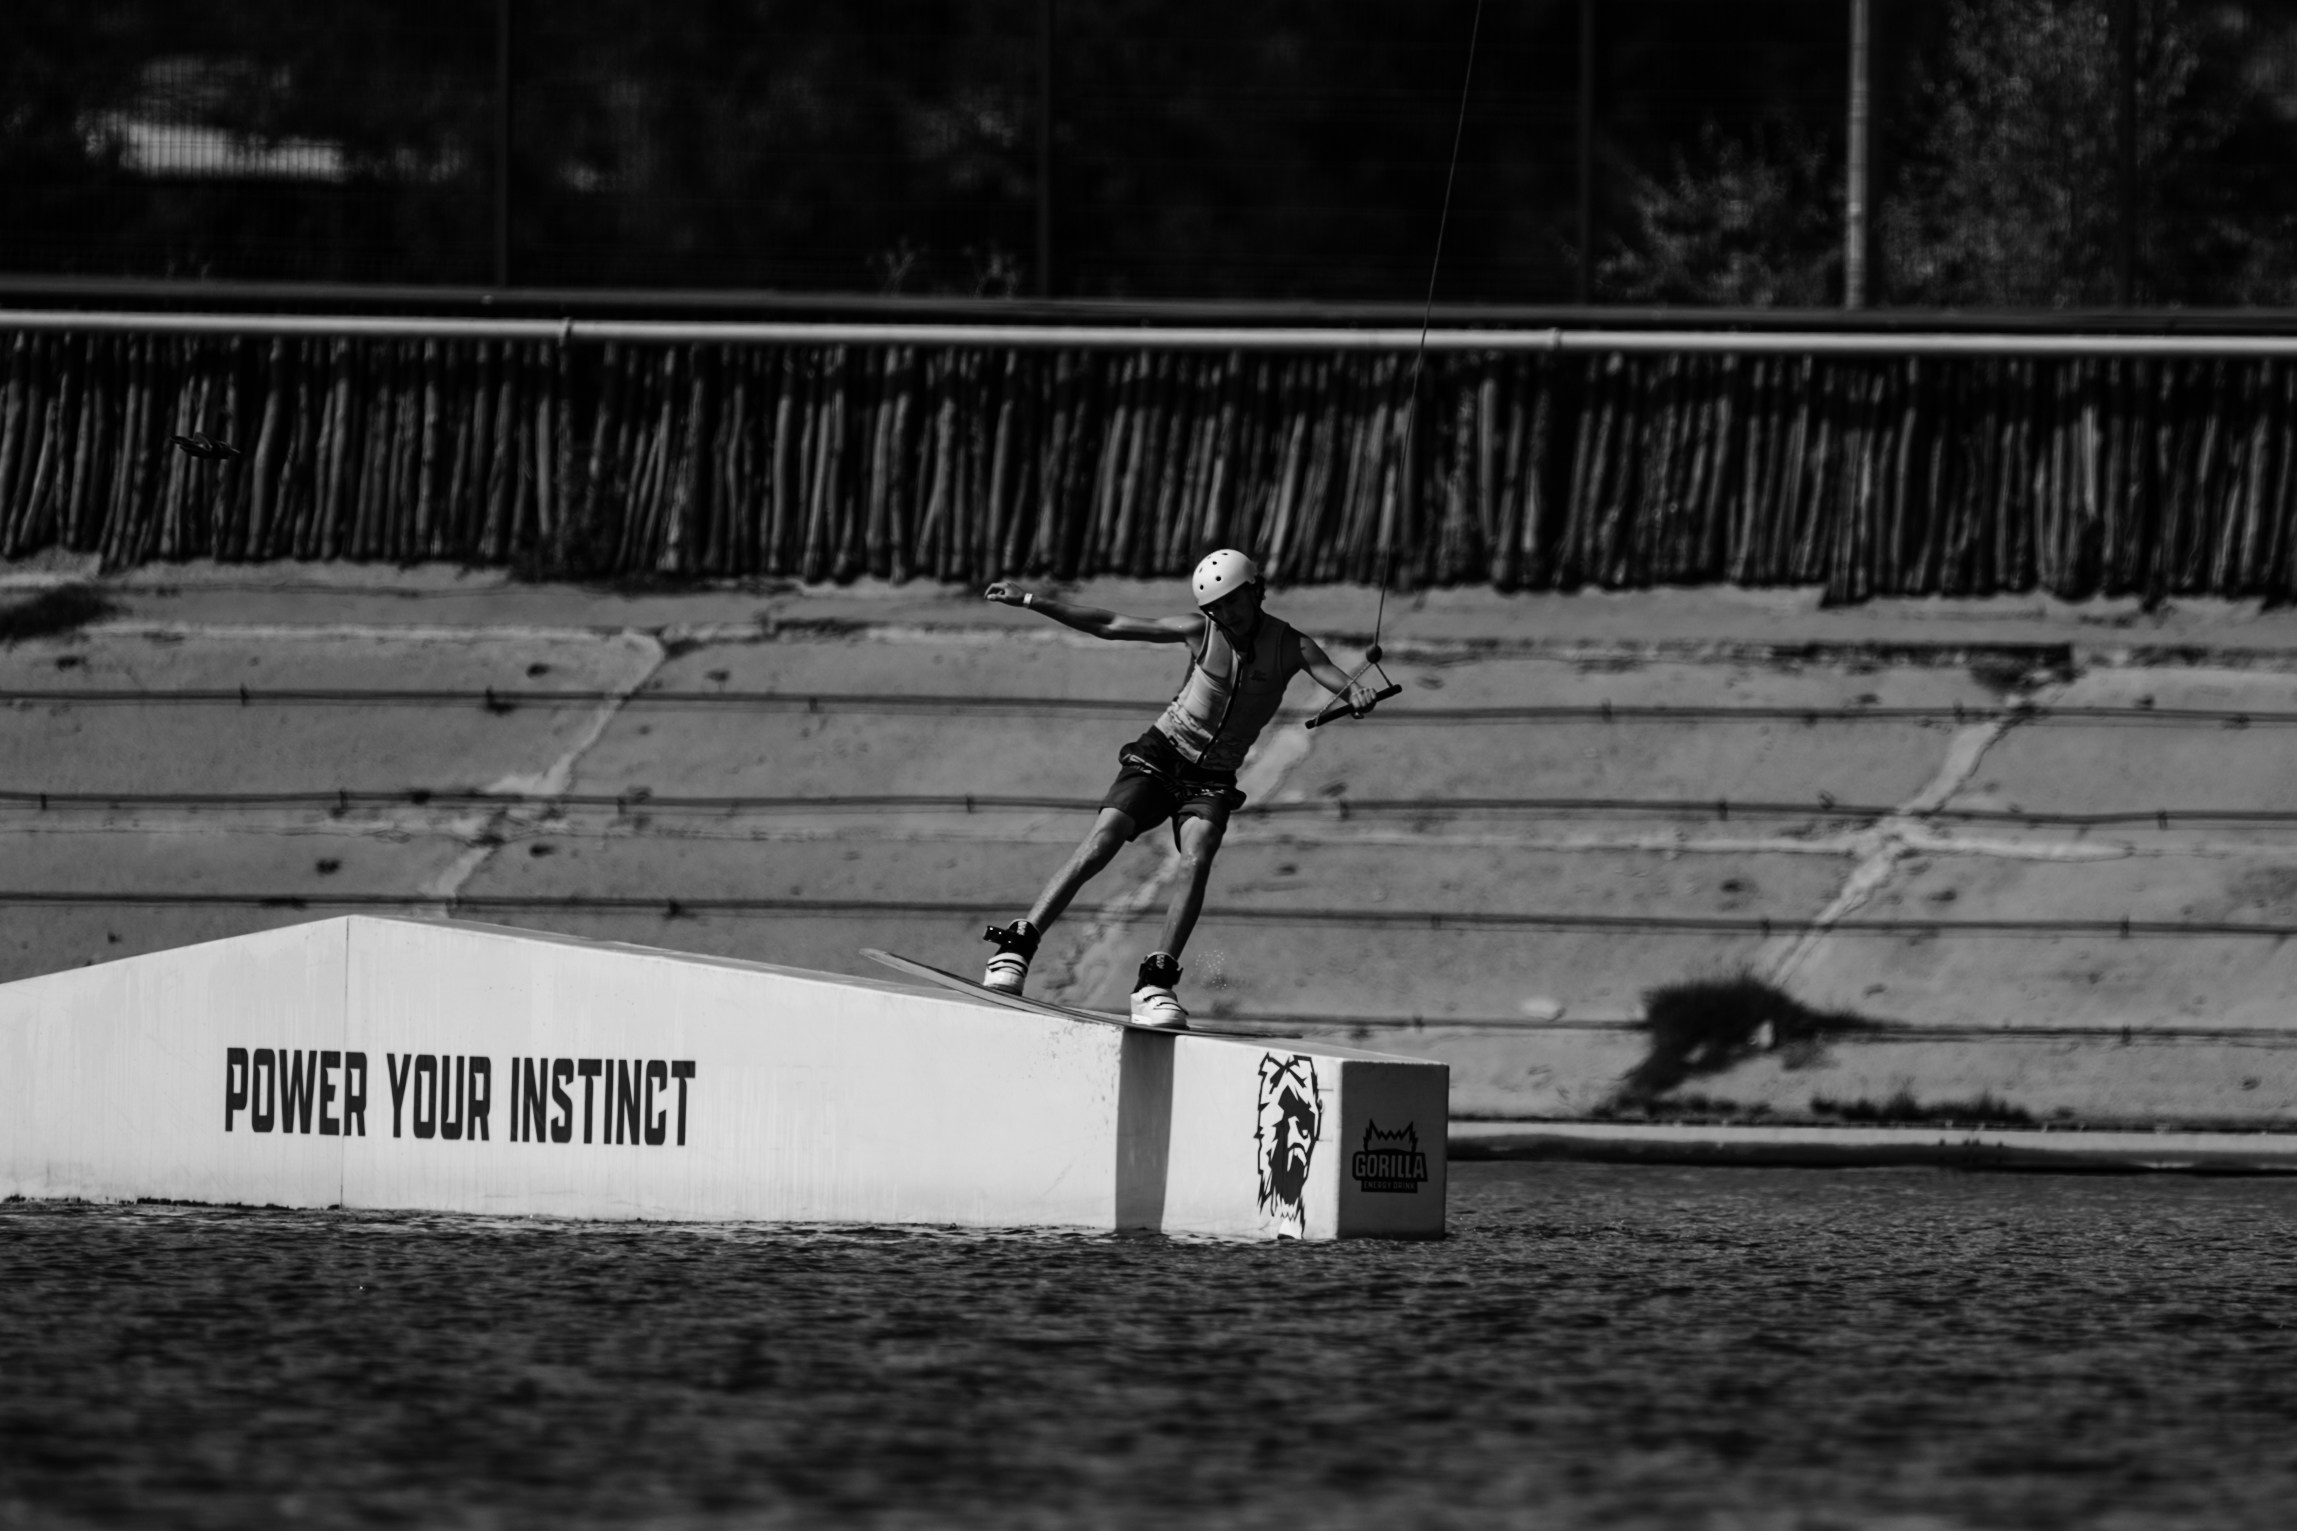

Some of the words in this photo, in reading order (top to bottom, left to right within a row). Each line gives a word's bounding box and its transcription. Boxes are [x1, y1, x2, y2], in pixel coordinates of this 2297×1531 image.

[225, 1047, 367, 1136] POWER
[387, 1053, 491, 1141] YOUR
[510, 1057, 696, 1146] INSTINCT
[1355, 1154, 1424, 1178] GORILLA
[1363, 1181, 1392, 1190] ENERGY
[1393, 1181, 1415, 1190] DRINK
